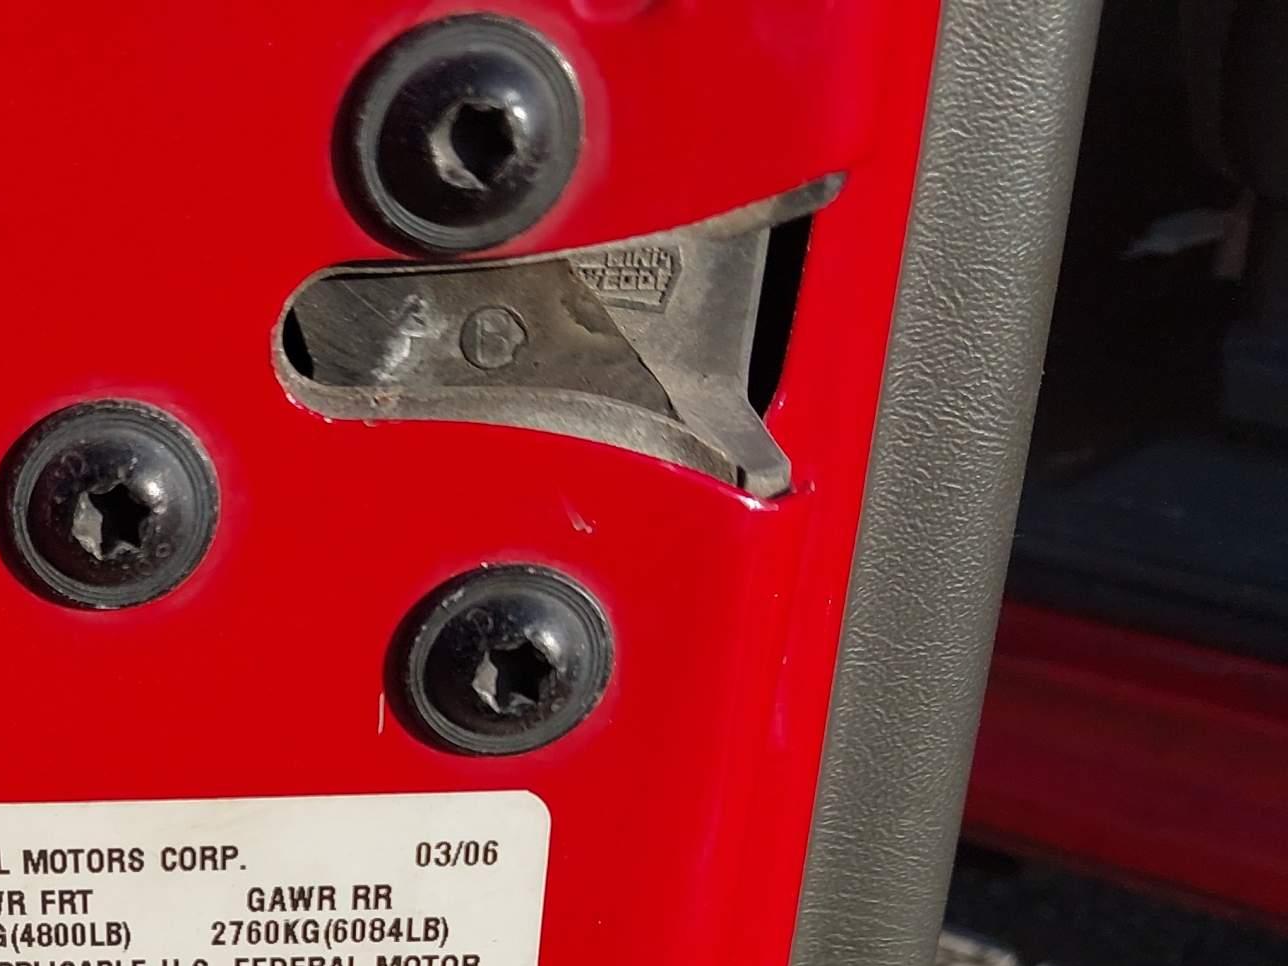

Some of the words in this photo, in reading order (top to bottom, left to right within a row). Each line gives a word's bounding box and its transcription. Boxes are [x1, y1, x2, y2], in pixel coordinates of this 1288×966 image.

[23, 848, 144, 874] MOTORS
[162, 846, 245, 871] CORP.
[416, 841, 498, 867] 03/06
[41, 890, 93, 915] FRT
[248, 886, 336, 912] GAWR
[352, 885, 392, 910] RR
[212, 917, 448, 949] 2760KG(6084LB)
